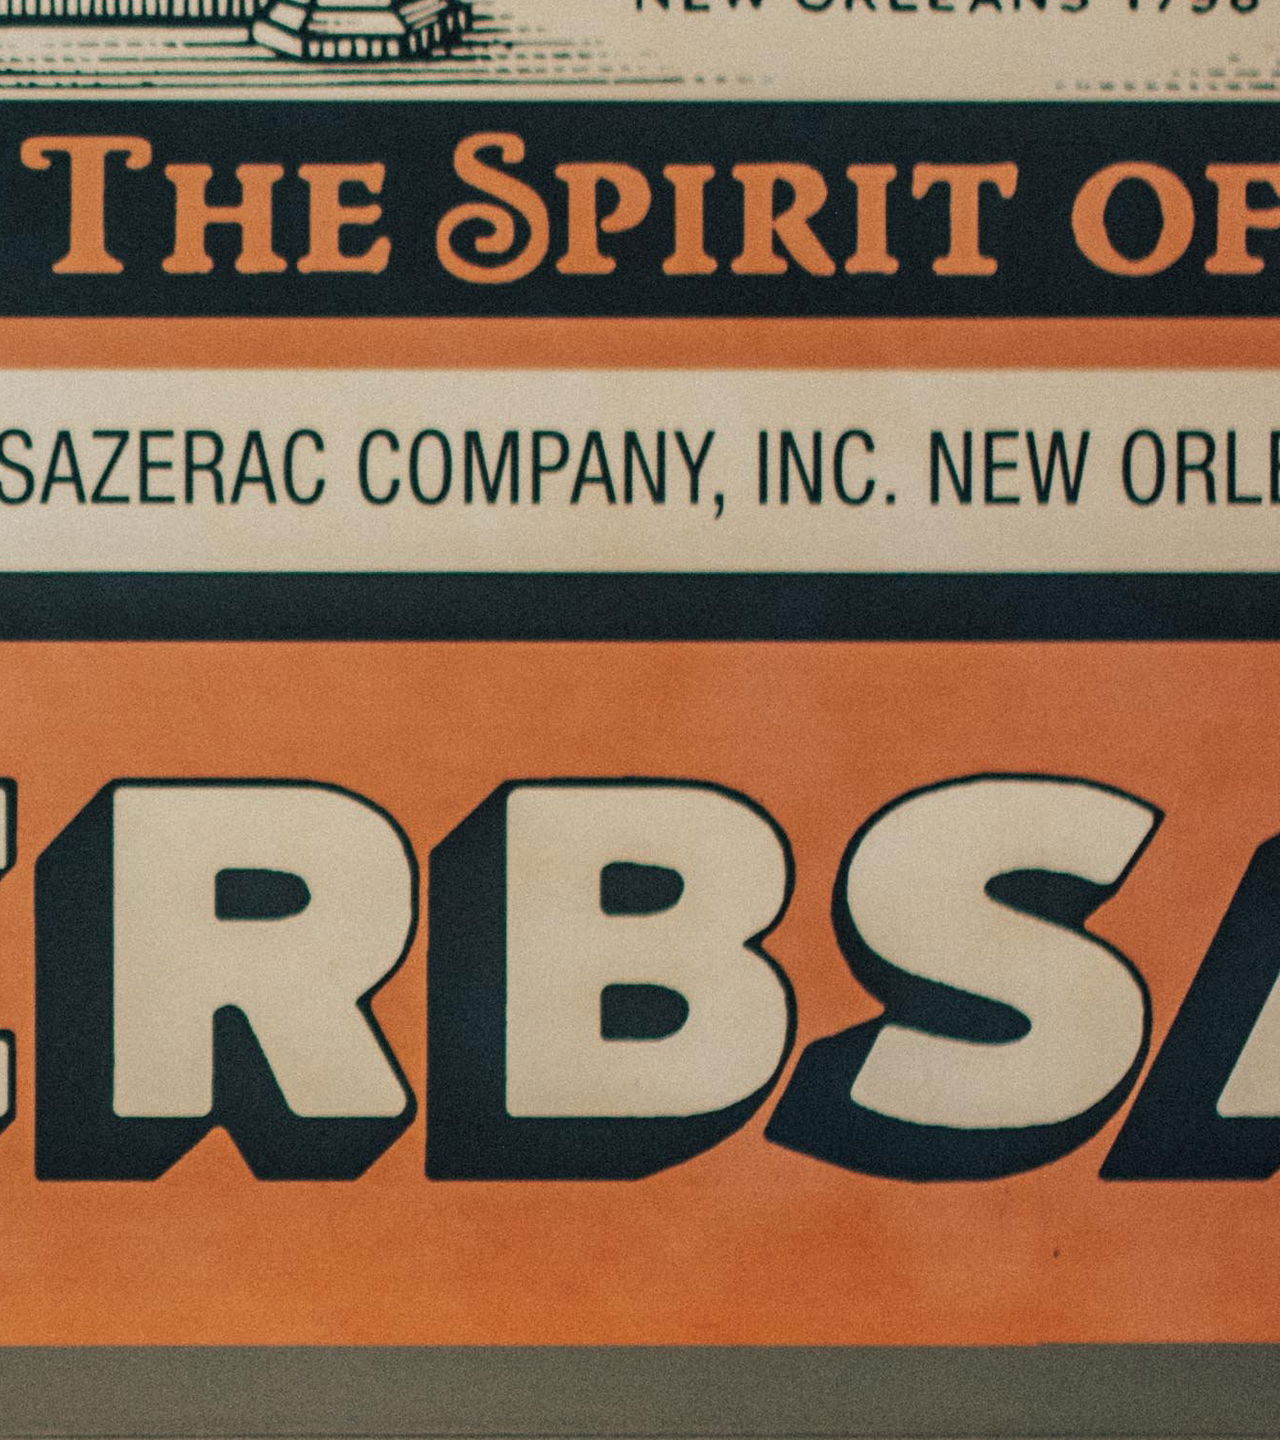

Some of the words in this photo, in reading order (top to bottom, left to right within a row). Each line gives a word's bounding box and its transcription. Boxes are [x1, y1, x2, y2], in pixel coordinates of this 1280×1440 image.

[358, 428, 725, 519] COMPANY,
[758, 428, 896, 507] INC.
[929, 429, 1091, 506] NEW
[1121, 428, 1280, 507] ORL
